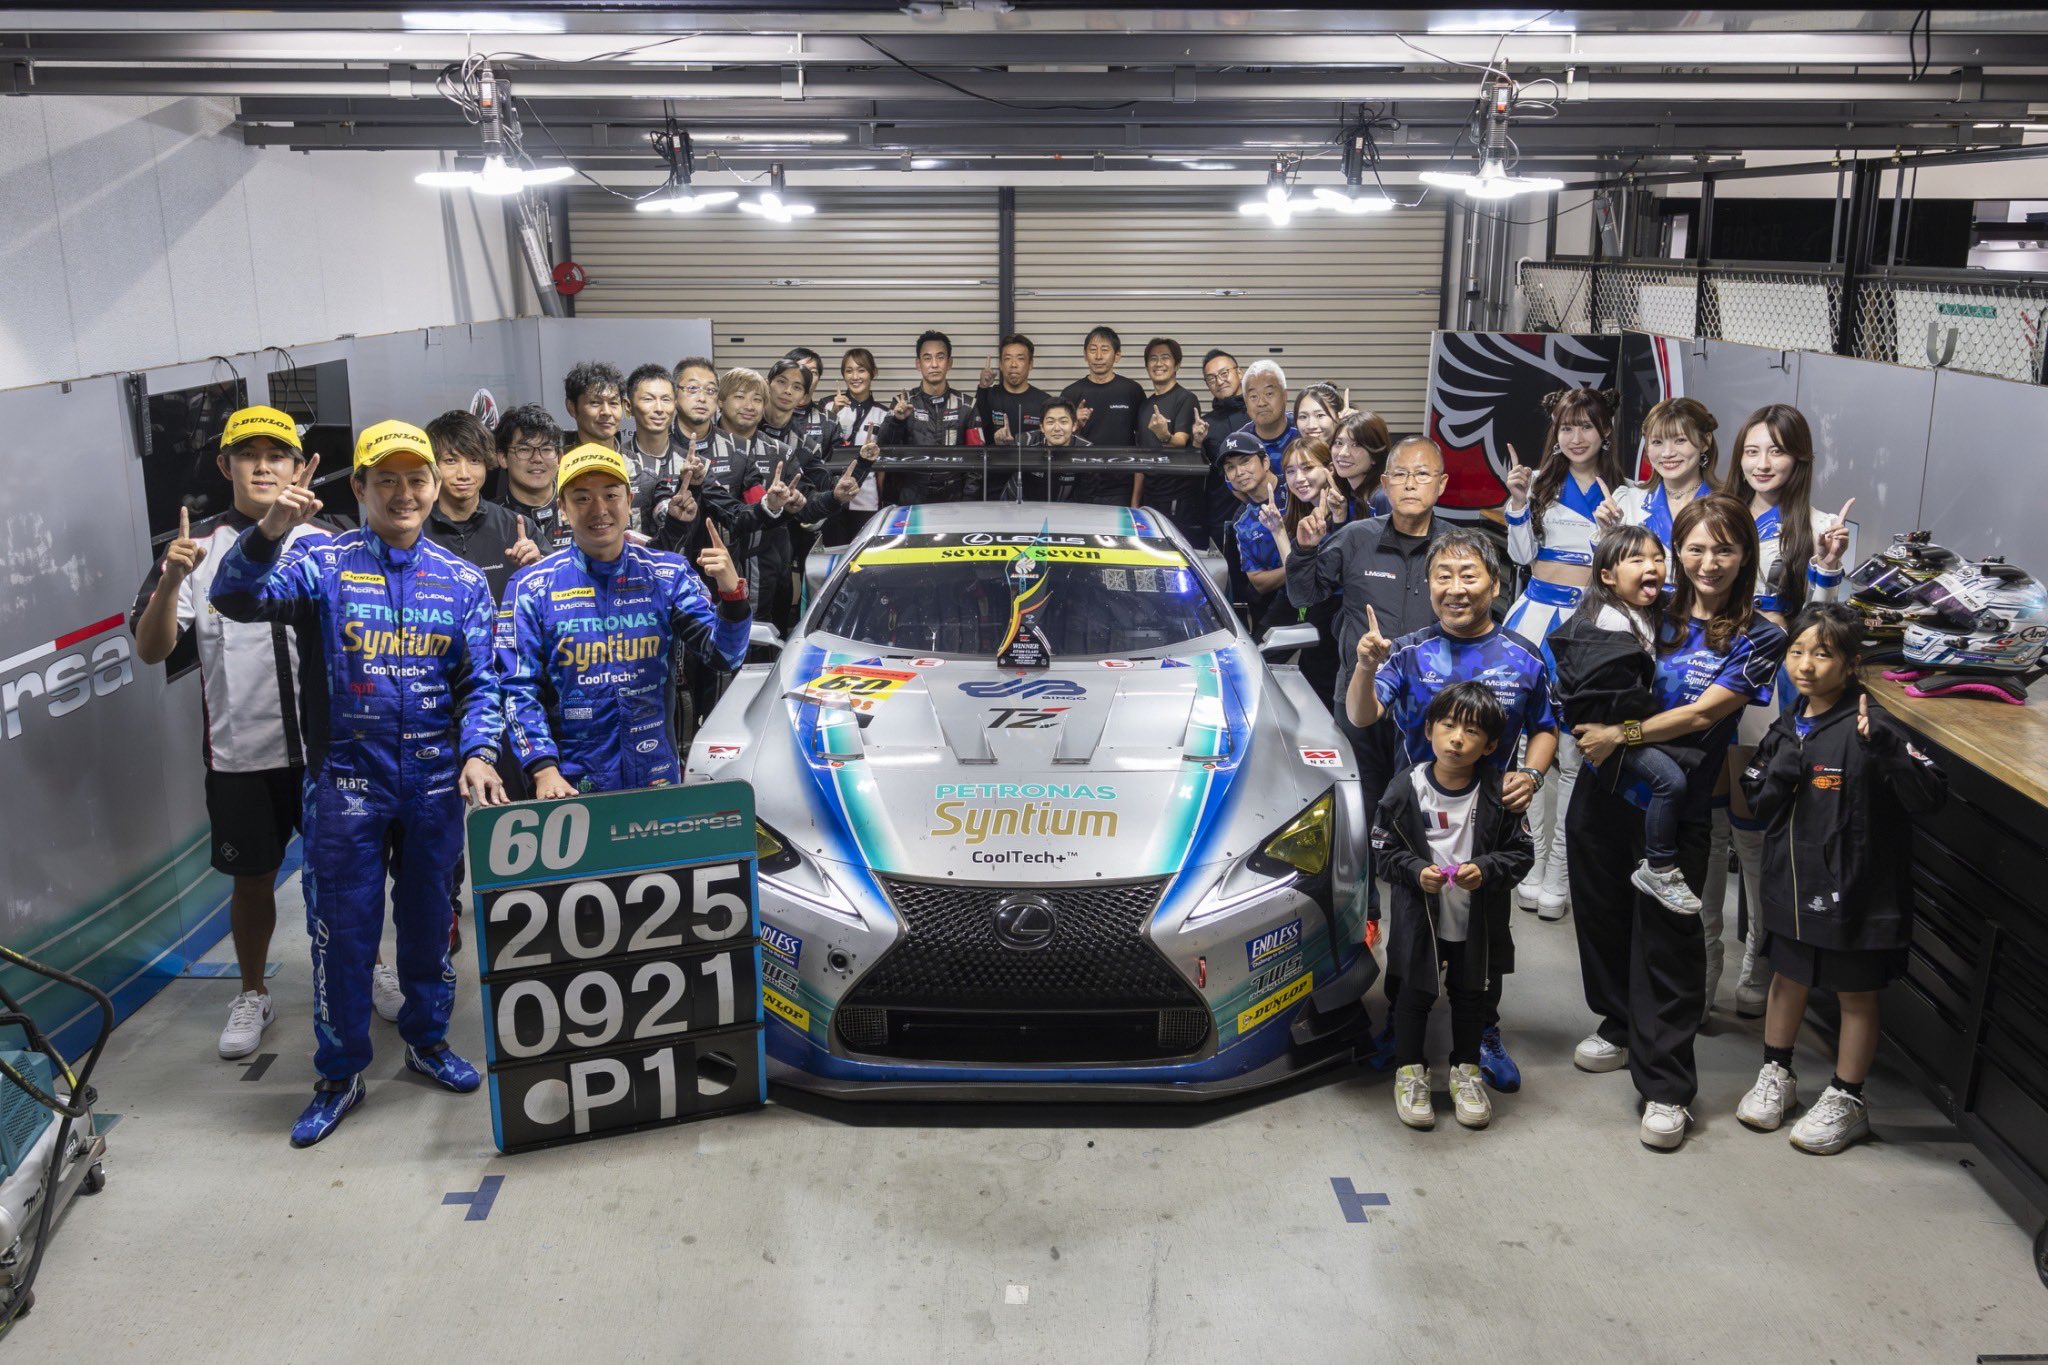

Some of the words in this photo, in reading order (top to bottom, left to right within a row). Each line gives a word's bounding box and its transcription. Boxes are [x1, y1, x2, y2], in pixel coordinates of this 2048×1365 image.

[241, 417, 291, 431] DUNLOP
[374, 433, 426, 445] DUNLOP
[571, 454, 621, 467] DUNLOP
[941, 546, 1008, 559] seven
[1035, 547, 1101, 560] seven
[996, 535, 1086, 546] LEXUS
[560, 588, 592, 598] DUNLOP
[623, 597, 652, 605] LEXUS
[345, 602, 454, 625] PETRONAS
[556, 612, 658, 635] PETRONAS
[342, 620, 452, 660] Syntium
[557, 632, 660, 672] Syntium
[0, 634, 134, 740] rsa
[818, 675, 892, 695] 60
[935, 783, 1117, 800] PETRONAS
[930, 801, 1118, 845] Syntium
[488, 802, 590, 876] 60
[610, 812, 742, 842] LMcorsa
[489, 863, 748, 971] 2025
[1252, 921, 1299, 959] ENDLESS
[763, 960, 799, 991] WS
[497, 952, 736, 1058] 0921
[763, 991, 804, 1020] NLOP
[1254, 980, 1308, 1019] DUNLOP
[568, 1047, 677, 1135] P1
